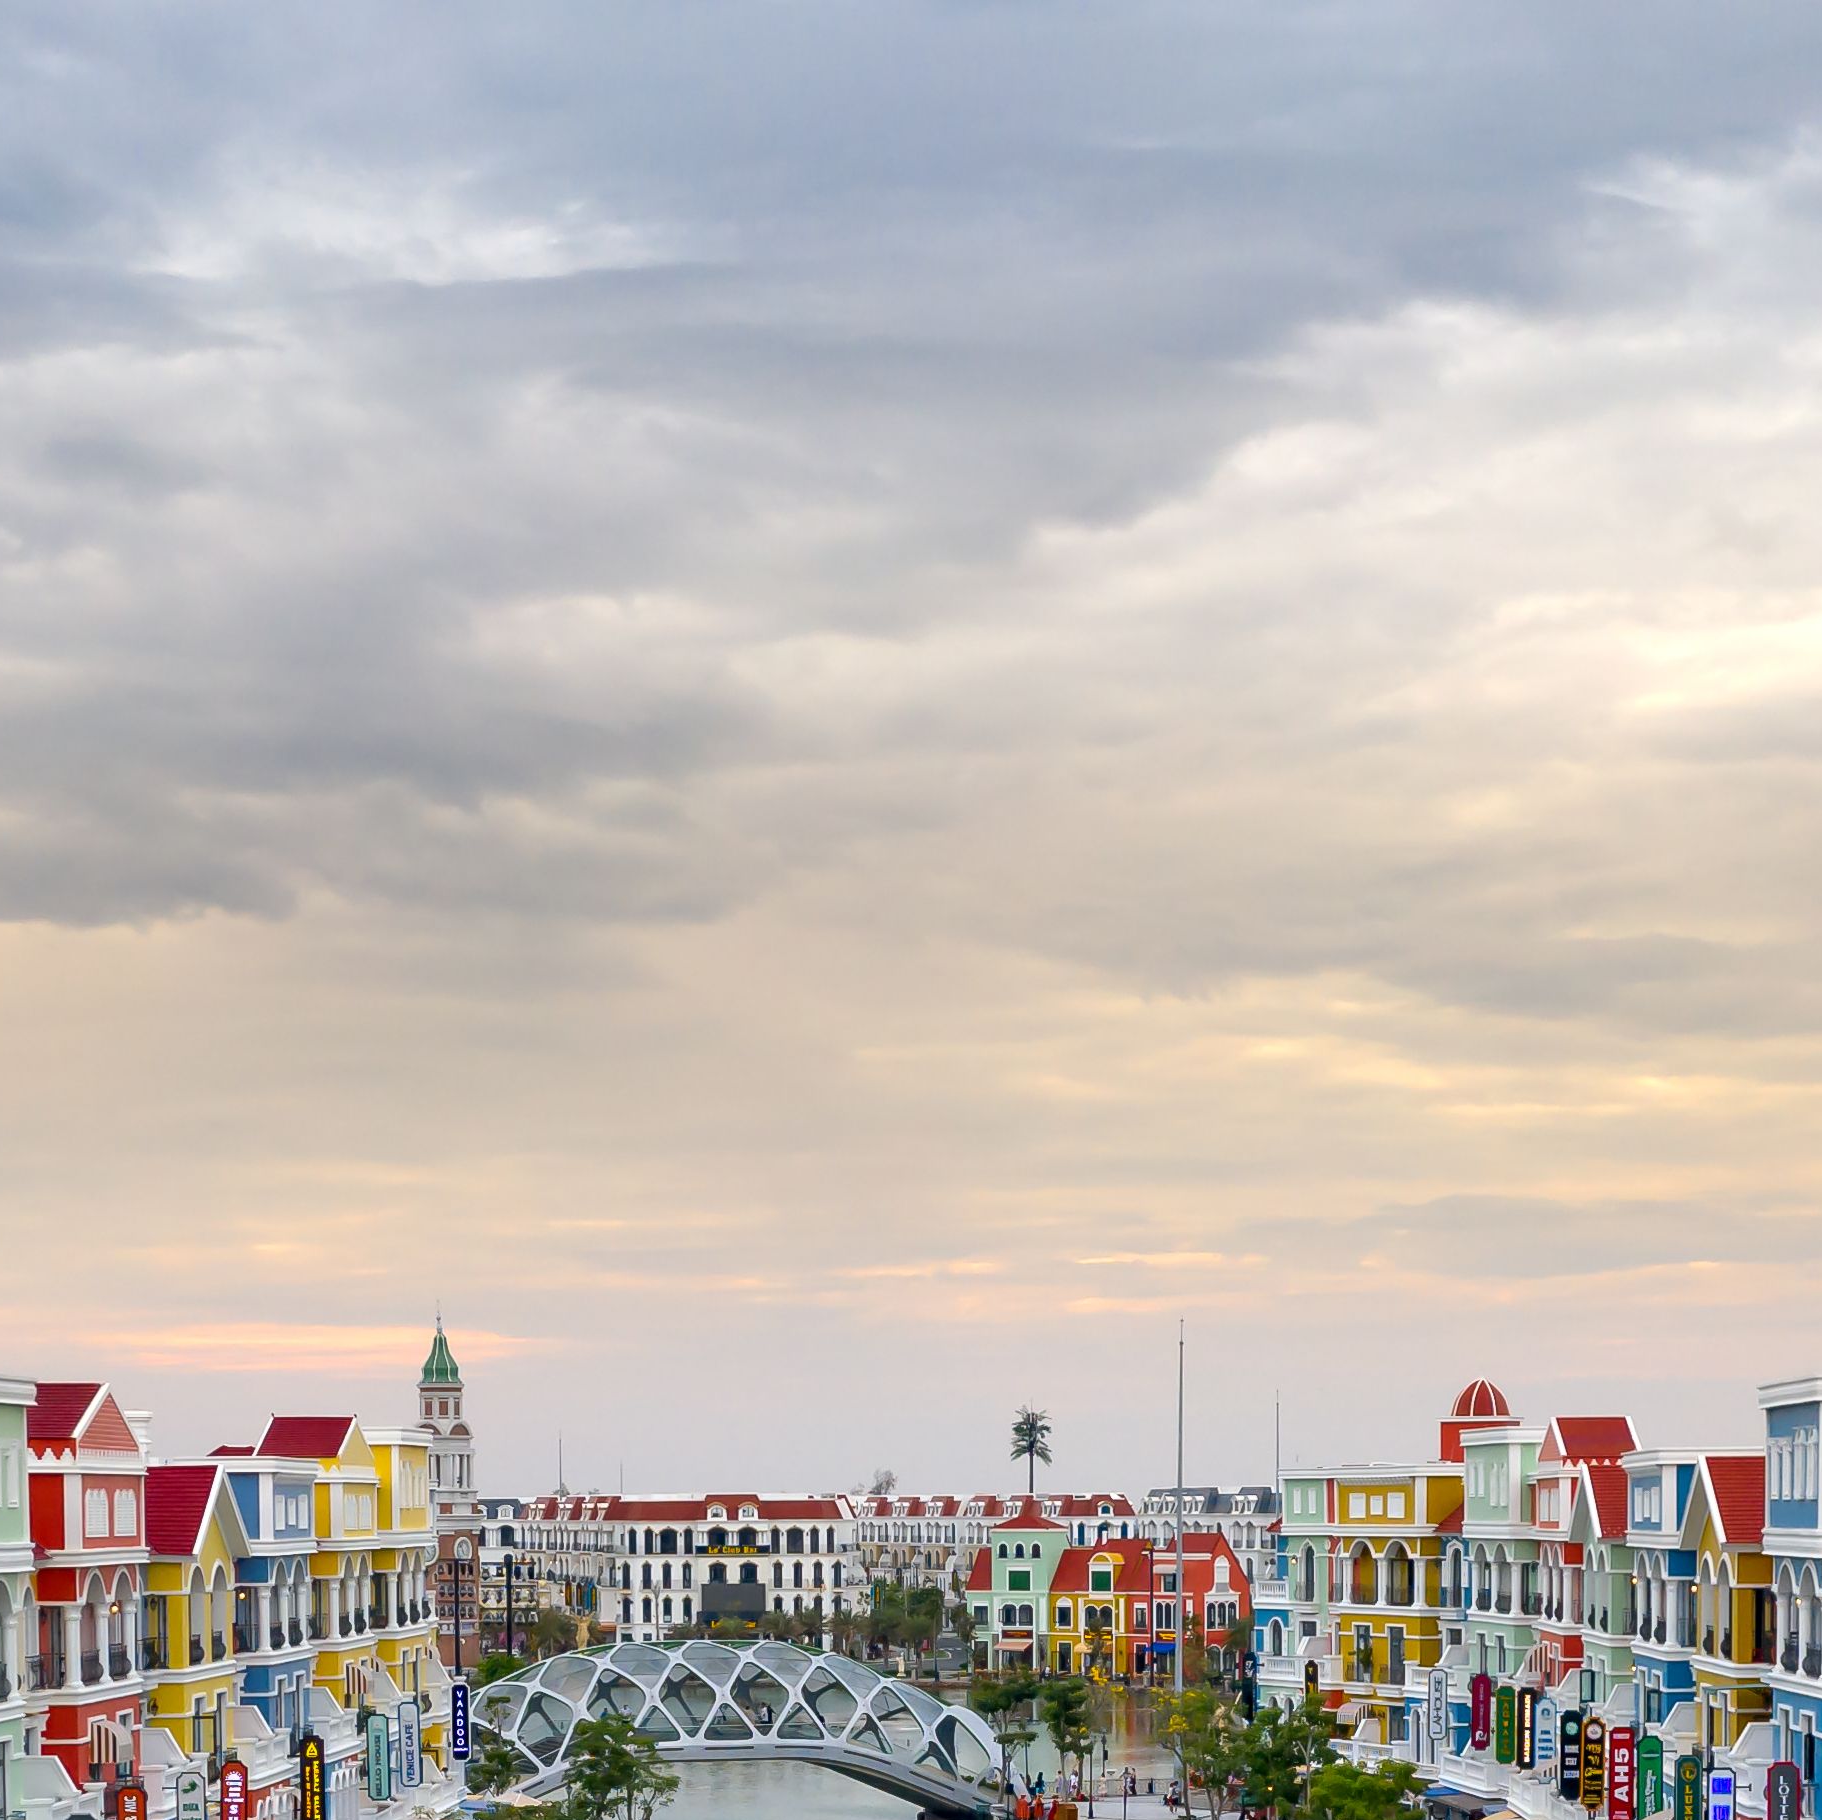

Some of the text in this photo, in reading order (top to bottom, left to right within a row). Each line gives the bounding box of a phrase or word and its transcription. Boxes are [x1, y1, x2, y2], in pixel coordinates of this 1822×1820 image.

[456, 1690, 465, 1746] VAADOO
[405, 1750, 416, 1782] VENICE
[124, 1795, 137, 1814] MIC
